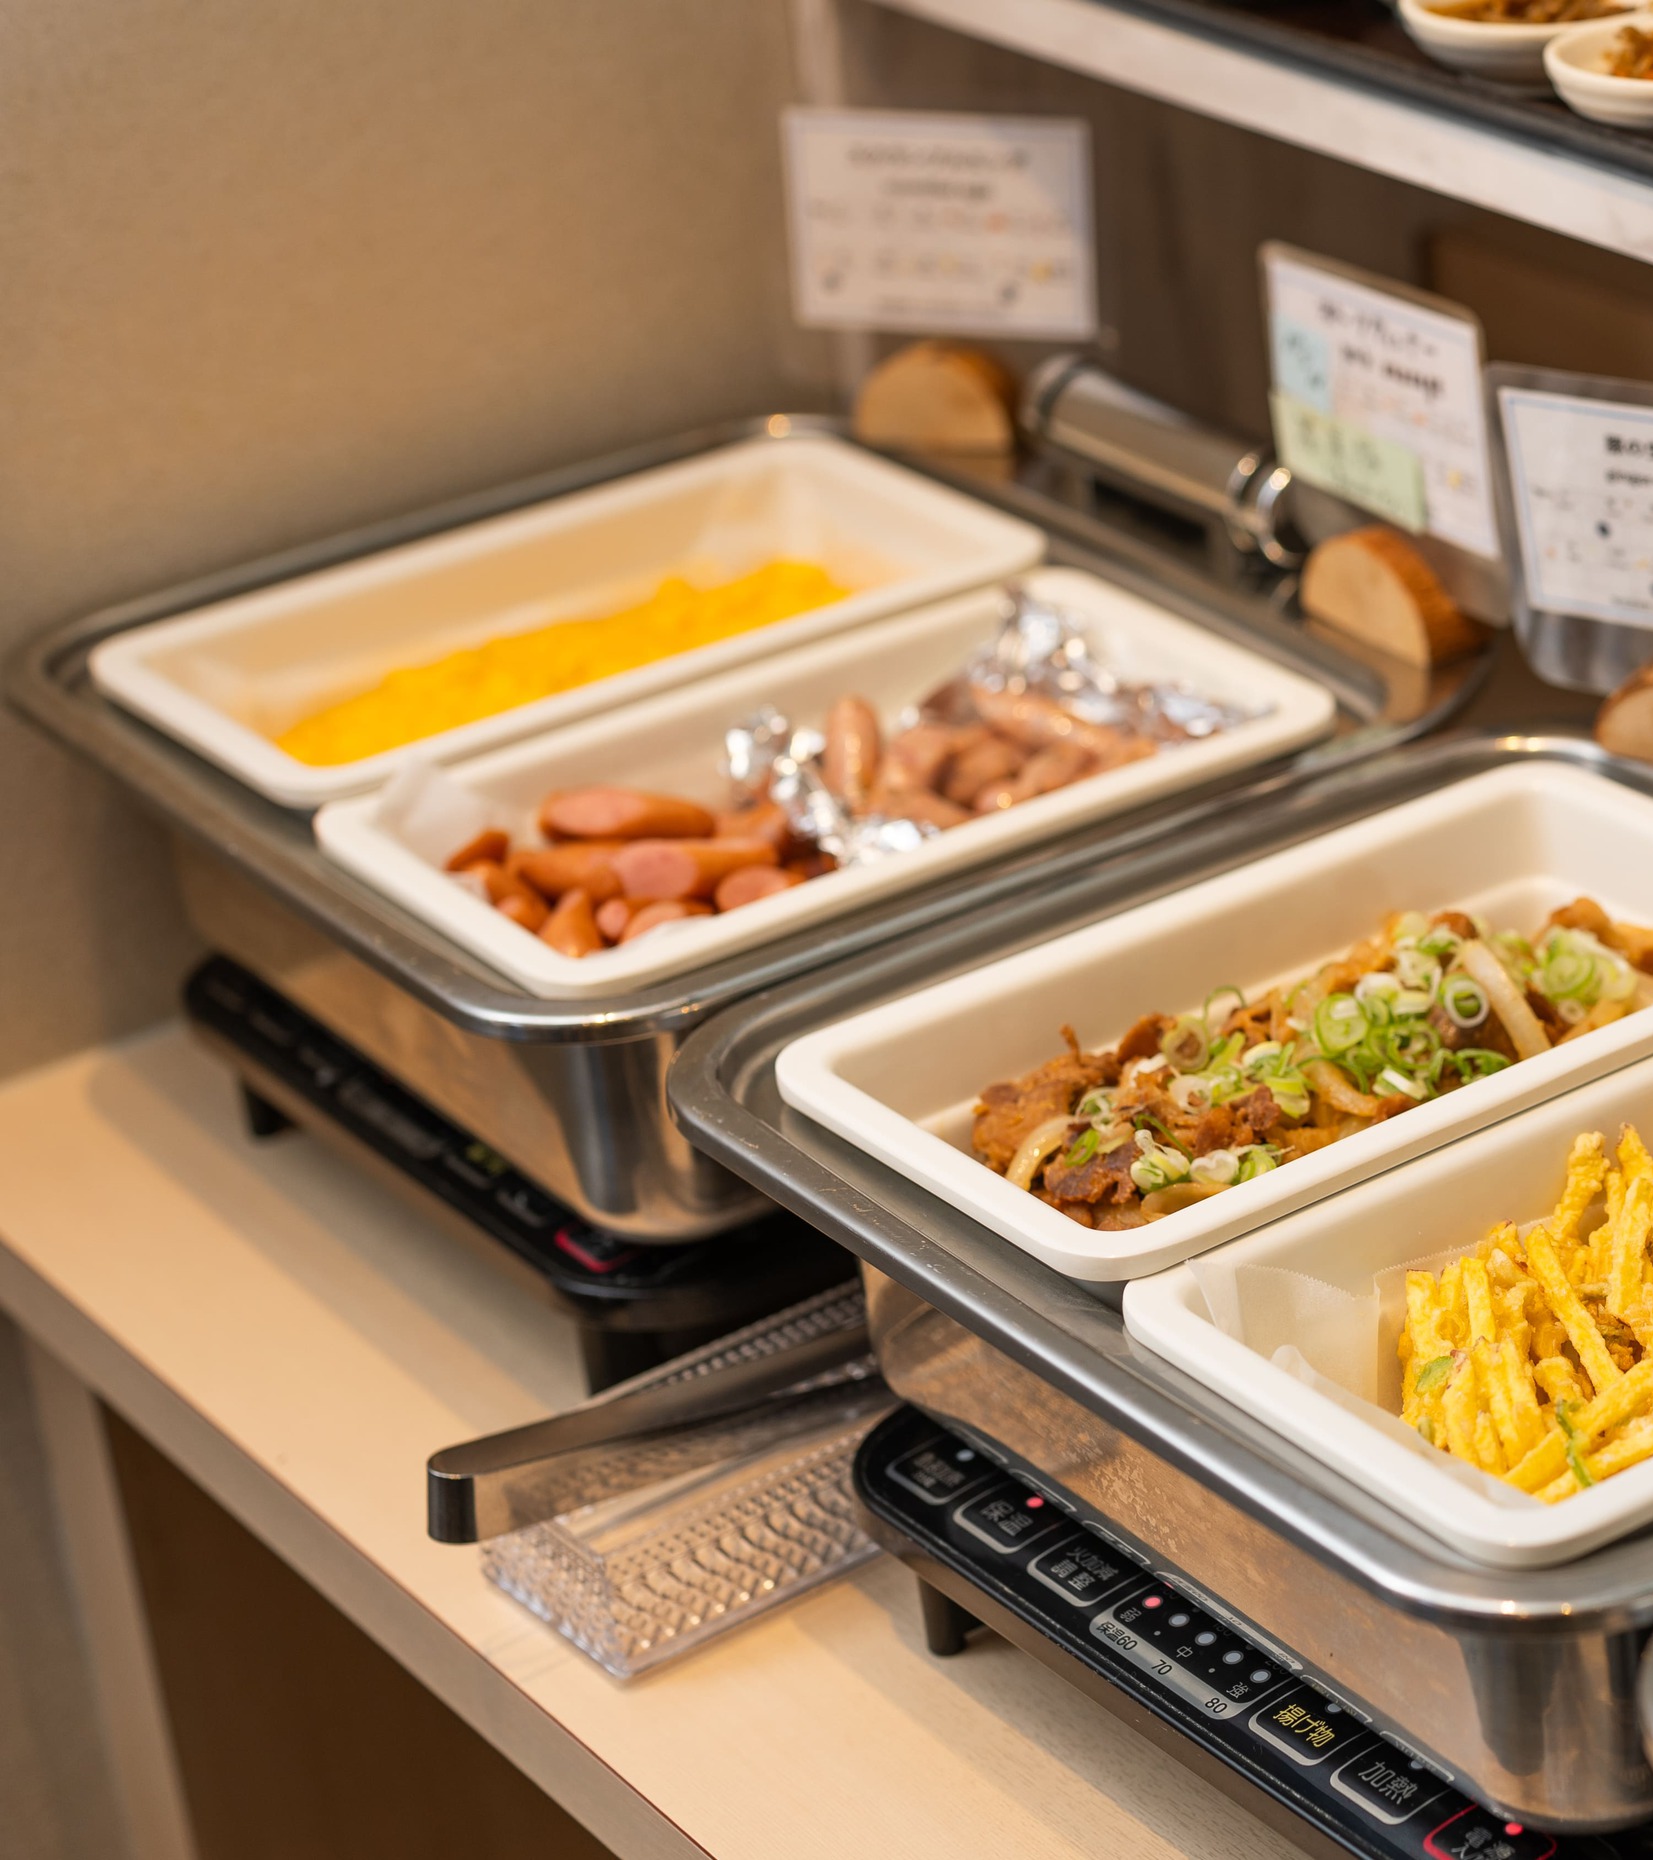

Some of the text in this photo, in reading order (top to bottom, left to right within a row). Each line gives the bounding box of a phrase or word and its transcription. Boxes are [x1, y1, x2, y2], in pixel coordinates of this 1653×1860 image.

[979, 1499, 1034, 1537] 保温
[1066, 1546, 1120, 1582] 火加減
[1176, 1645, 1193, 1659] 中
[1151, 1658, 1174, 1676] 70
[1225, 1681, 1250, 1699] 強
[1204, 1697, 1228, 1714] 80
[1272, 1703, 1336, 1748] 揚げ物
[1357, 1761, 1419, 1805] 加熱
